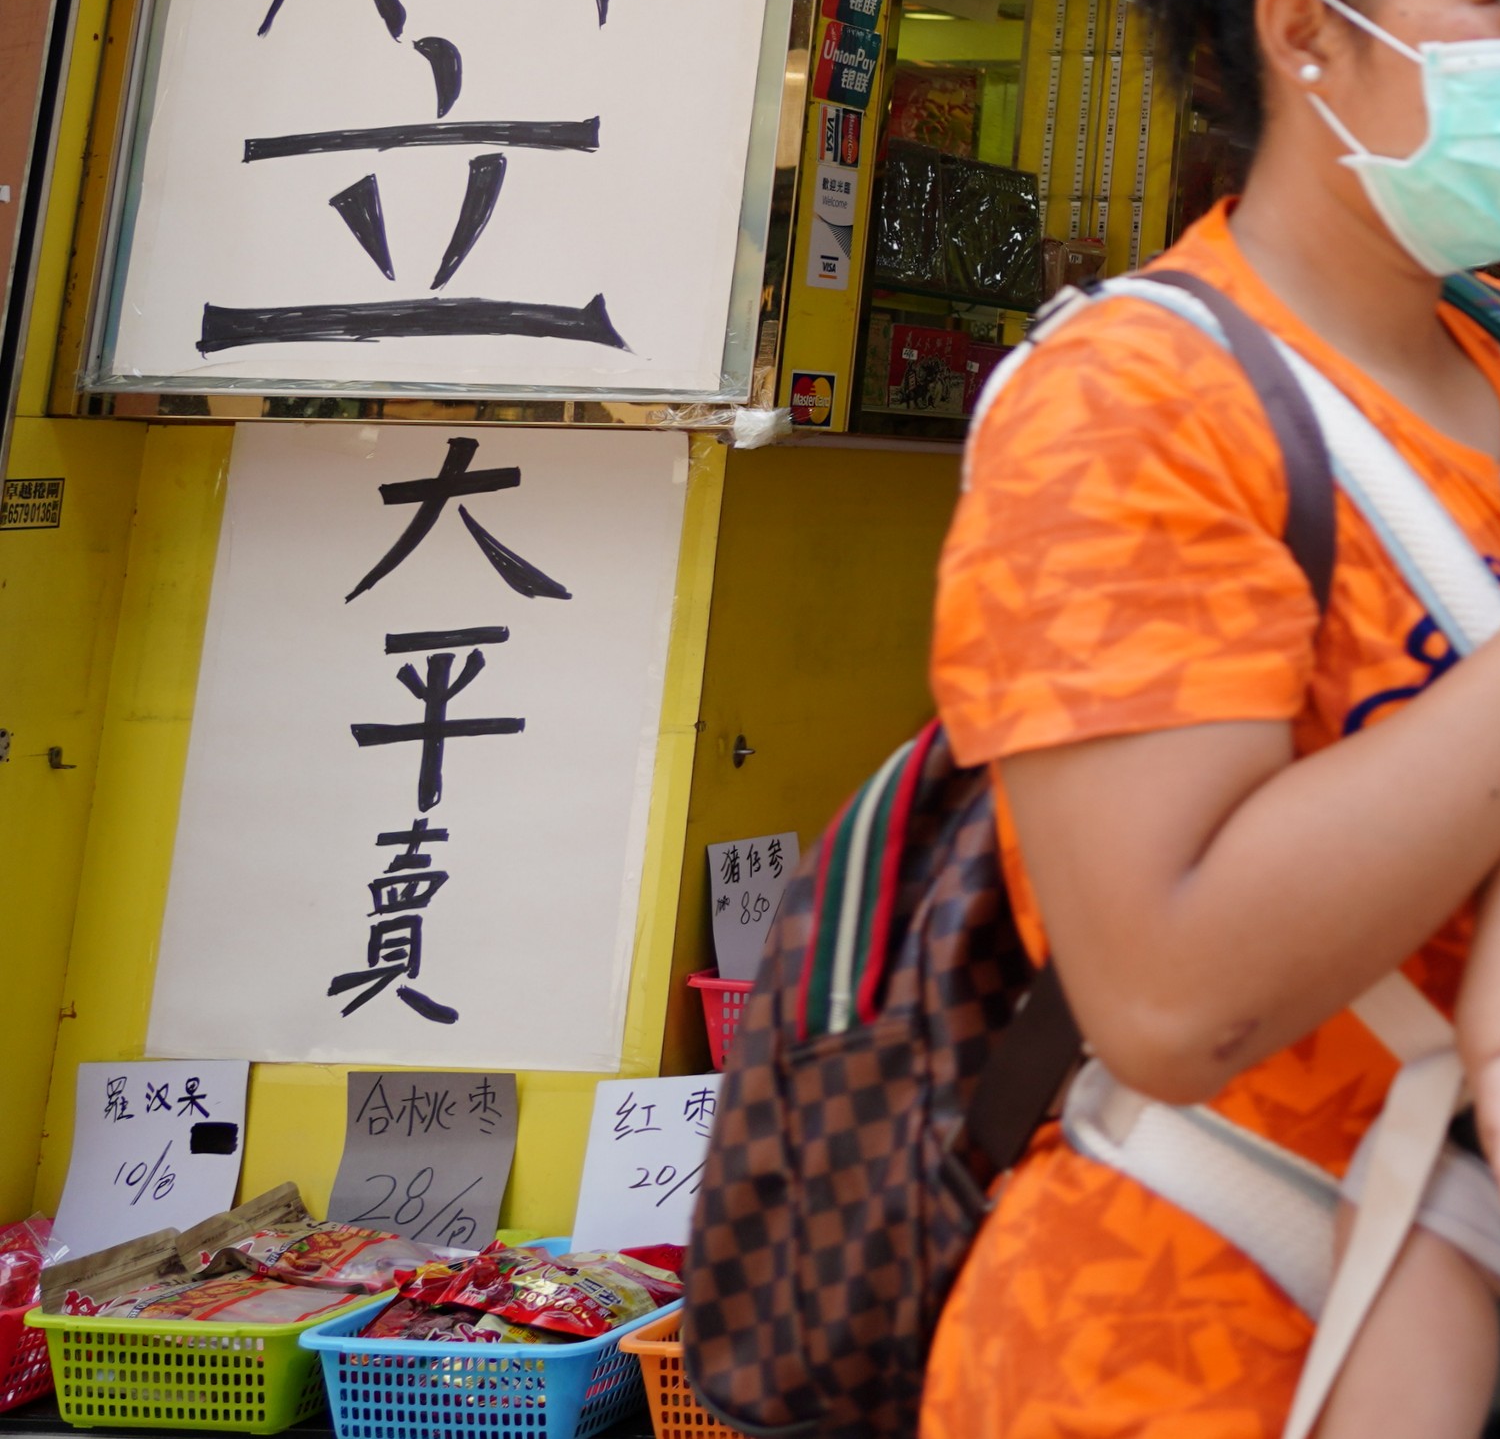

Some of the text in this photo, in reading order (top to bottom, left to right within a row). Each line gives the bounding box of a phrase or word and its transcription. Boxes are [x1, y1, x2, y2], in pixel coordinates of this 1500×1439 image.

[823, 39, 876, 78] UnionPay
[825, 116, 835, 152] VISA
[821, 194, 849, 210] Welcome
[822, 261, 837, 273] VISA
[793, 392, 831, 408] MasterCard
[327, 437, 573, 1025] 大平賣
[629, 1163, 706, 1208] 20/
